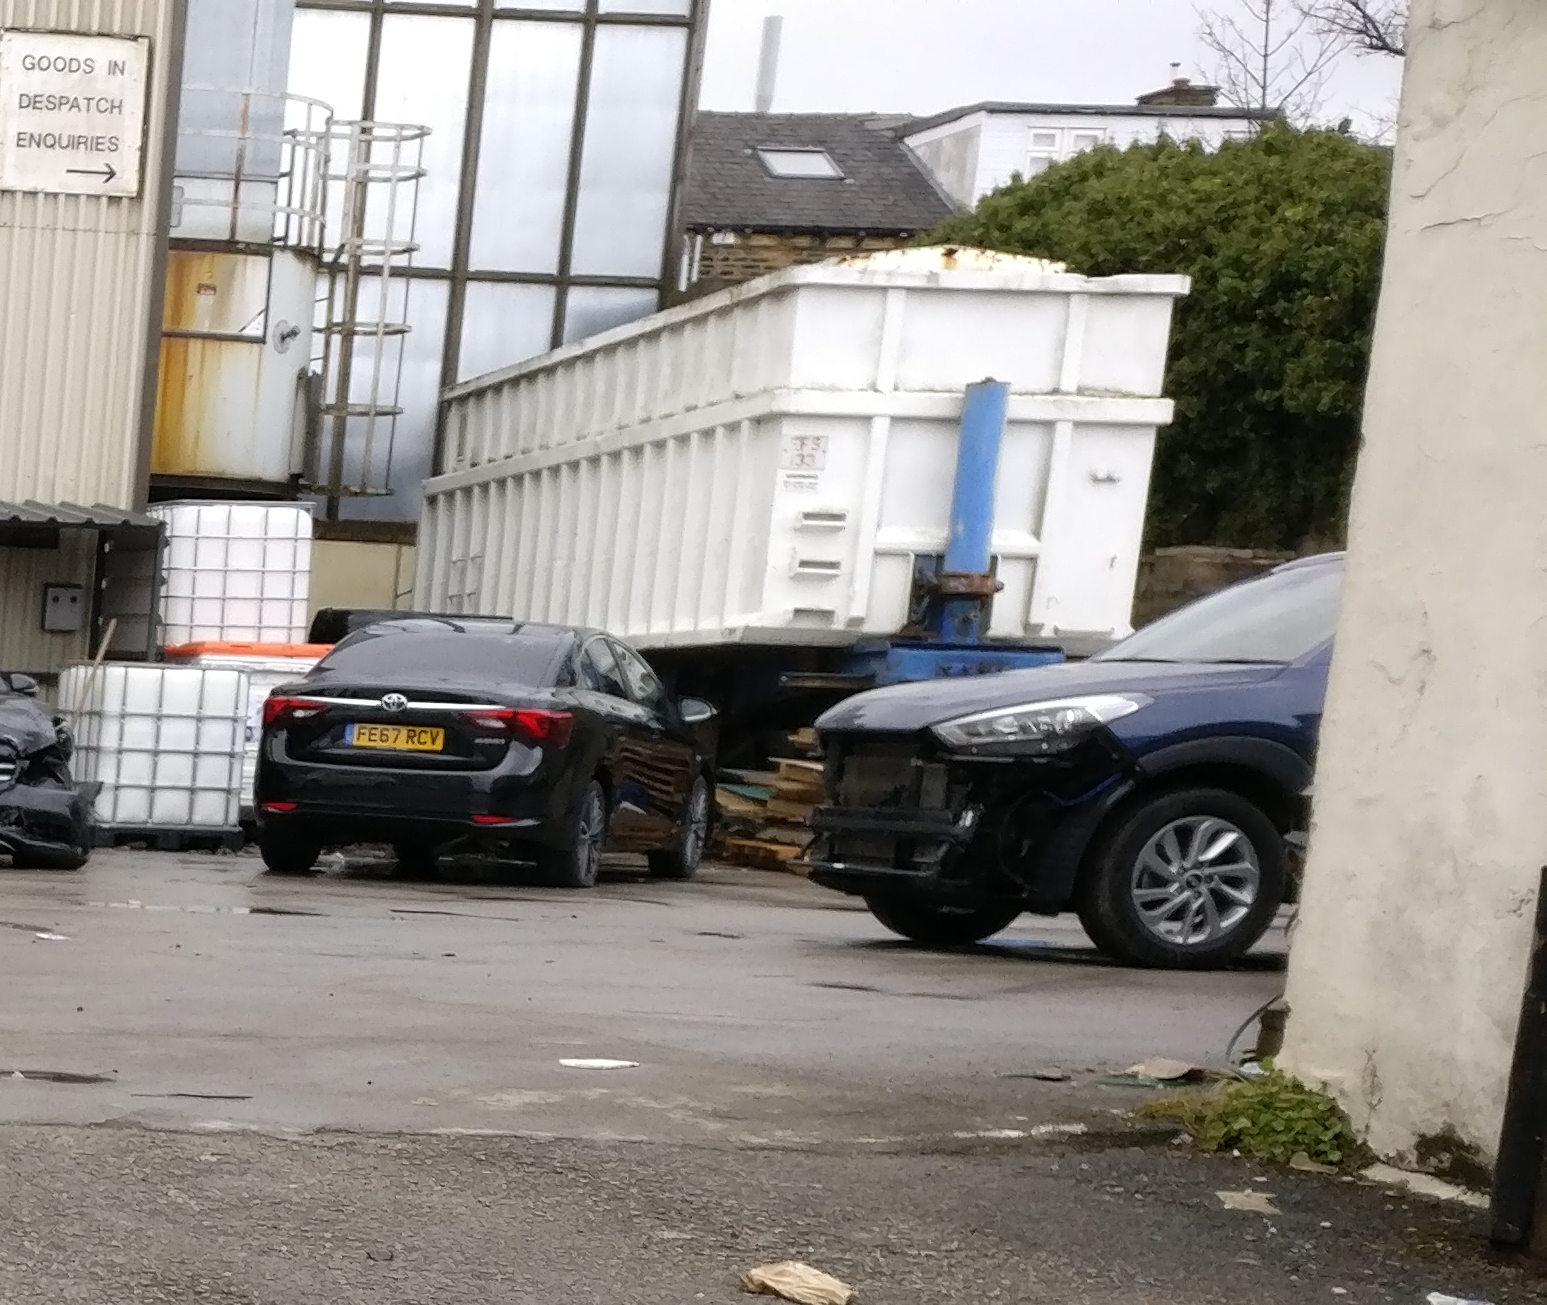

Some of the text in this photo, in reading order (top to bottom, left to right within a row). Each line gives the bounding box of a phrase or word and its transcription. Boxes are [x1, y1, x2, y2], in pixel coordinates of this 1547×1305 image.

[21, 53, 126, 77] GOODS IN
[17, 92, 124, 116] DESPATCH
[15, 131, 120, 152] ENQUIRIES
[356, 725, 441, 746] FE67 RCV
